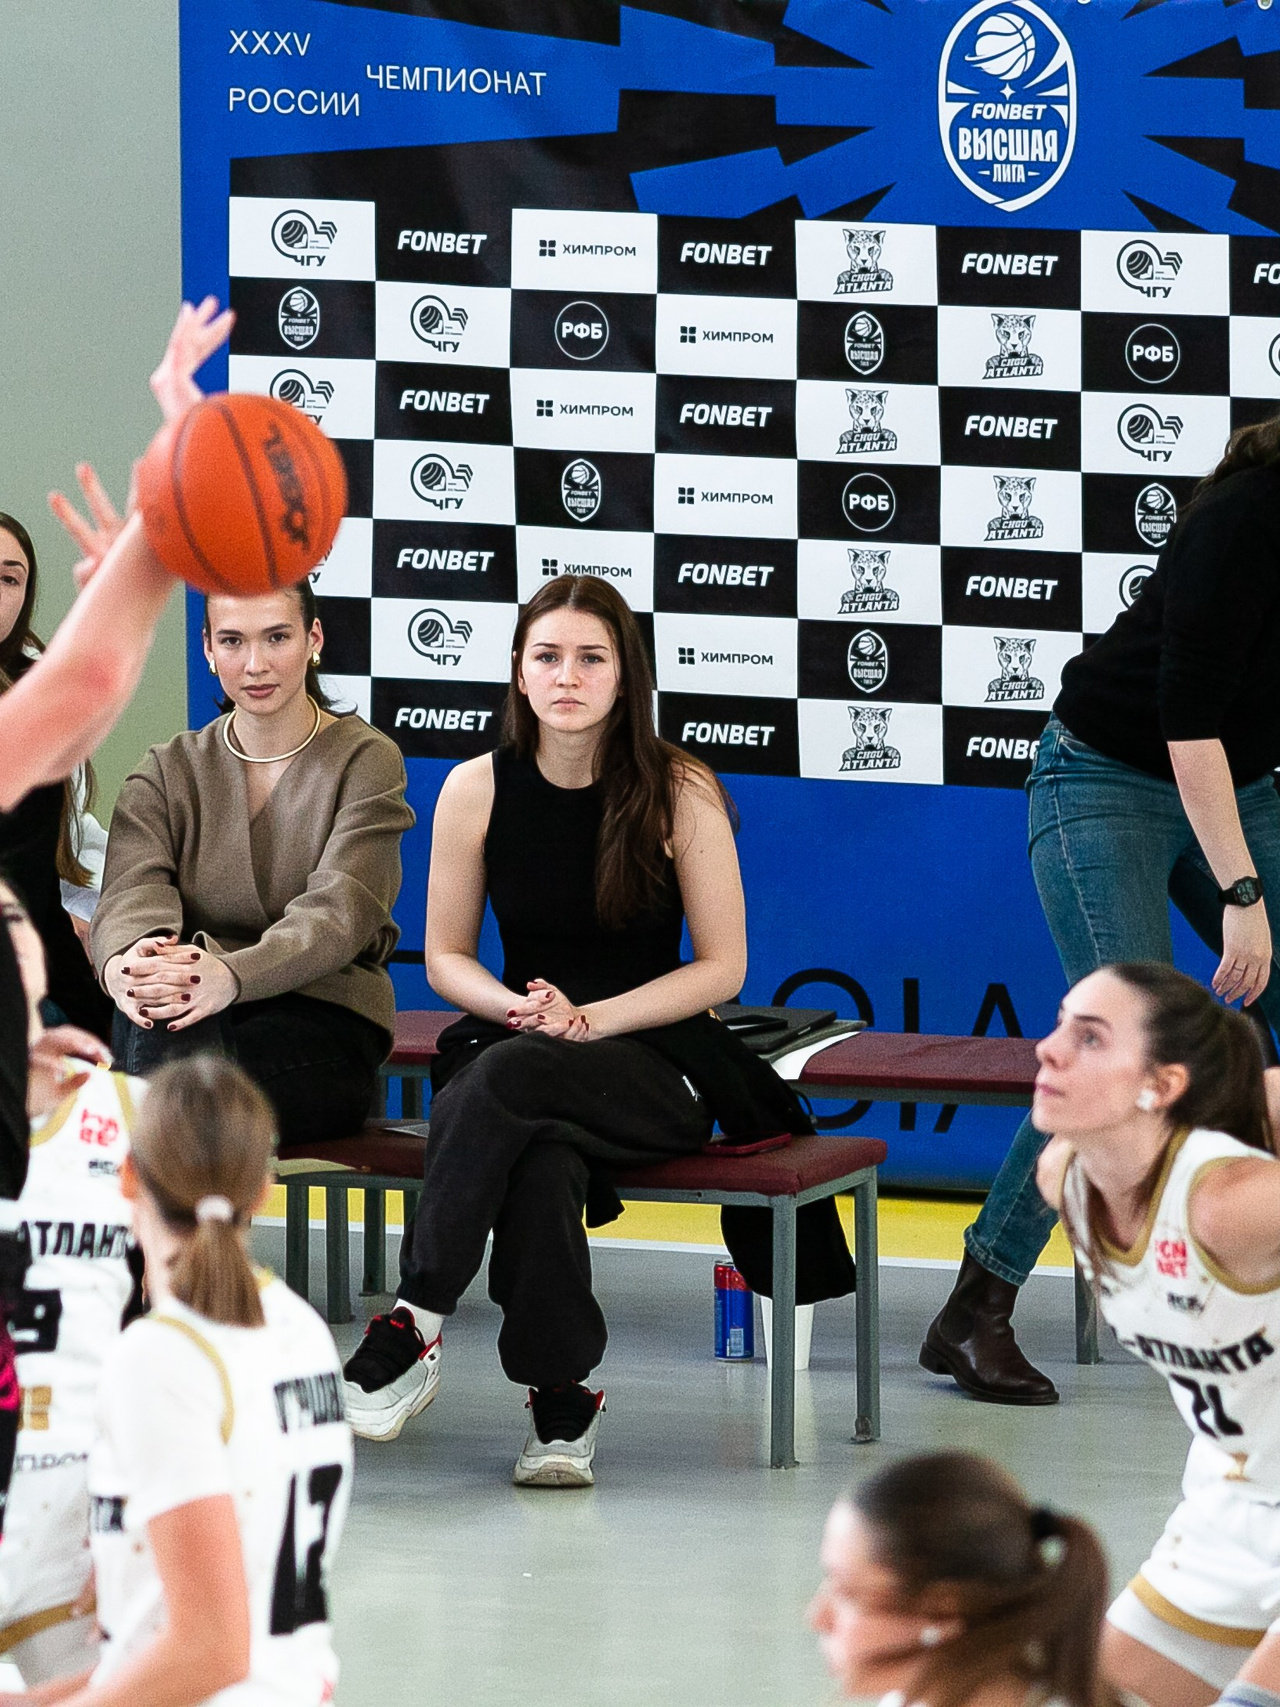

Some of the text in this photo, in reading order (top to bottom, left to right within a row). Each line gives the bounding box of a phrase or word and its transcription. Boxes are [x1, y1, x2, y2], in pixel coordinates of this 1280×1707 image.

[229, 30, 310, 56] XXXV
[366, 65, 547, 96] ЧЕМПИОНАТ
[229, 88, 360, 117] РОССИИ
[971, 102, 1048, 120] FONBET
[958, 127, 1058, 163] ВЫСШАЯ
[992, 163, 1026, 183] ЛИГА
[397, 229, 488, 255] FONBET
[562, 244, 636, 257] ХИМПРОМ
[293, 254, 326, 267] ЧГУ
[679, 241, 773, 266] FONBET
[961, 252, 1059, 277] FONBET
[837, 281, 892, 293] ATLANTA
[1140, 285, 1172, 298] ЧГУ
[561, 321, 603, 340] РФБ
[702, 330, 774, 344] ХИМПРОМ
[431, 340, 460, 353] ЧГУ
[1132, 344, 1174, 363] РФБ
[986, 365, 1042, 378] ATLANTA
[399, 389, 490, 414] FONBET
[559, 404, 634, 417] ХИМПРОМ
[679, 403, 773, 428] FONBET
[964, 414, 1059, 439] FONBET
[840, 440, 896, 453] ATLANTA
[1140, 449, 1173, 463] ЧГУ
[433, 497, 464, 511] ЧГУ
[701, 491, 773, 505] ХИМПРОМ
[848, 493, 890, 511] РФБ
[987, 527, 1042, 540] ATLANTA
[396, 548, 495, 572] FONBET
[563, 563, 632, 577] ХИМПРОМ
[677, 562, 775, 587] FONBET
[965, 575, 1059, 601] FONBET
[841, 600, 898, 613] ATLANTA
[430, 653, 462, 666] ЧГУ
[701, 652, 774, 666] ХИМПРОМ
[988, 689, 1043, 701] ATLANTA
[394, 707, 493, 732] FONBET
[681, 721, 776, 746] FONBET
[842, 757, 900, 770] ATLANTA
